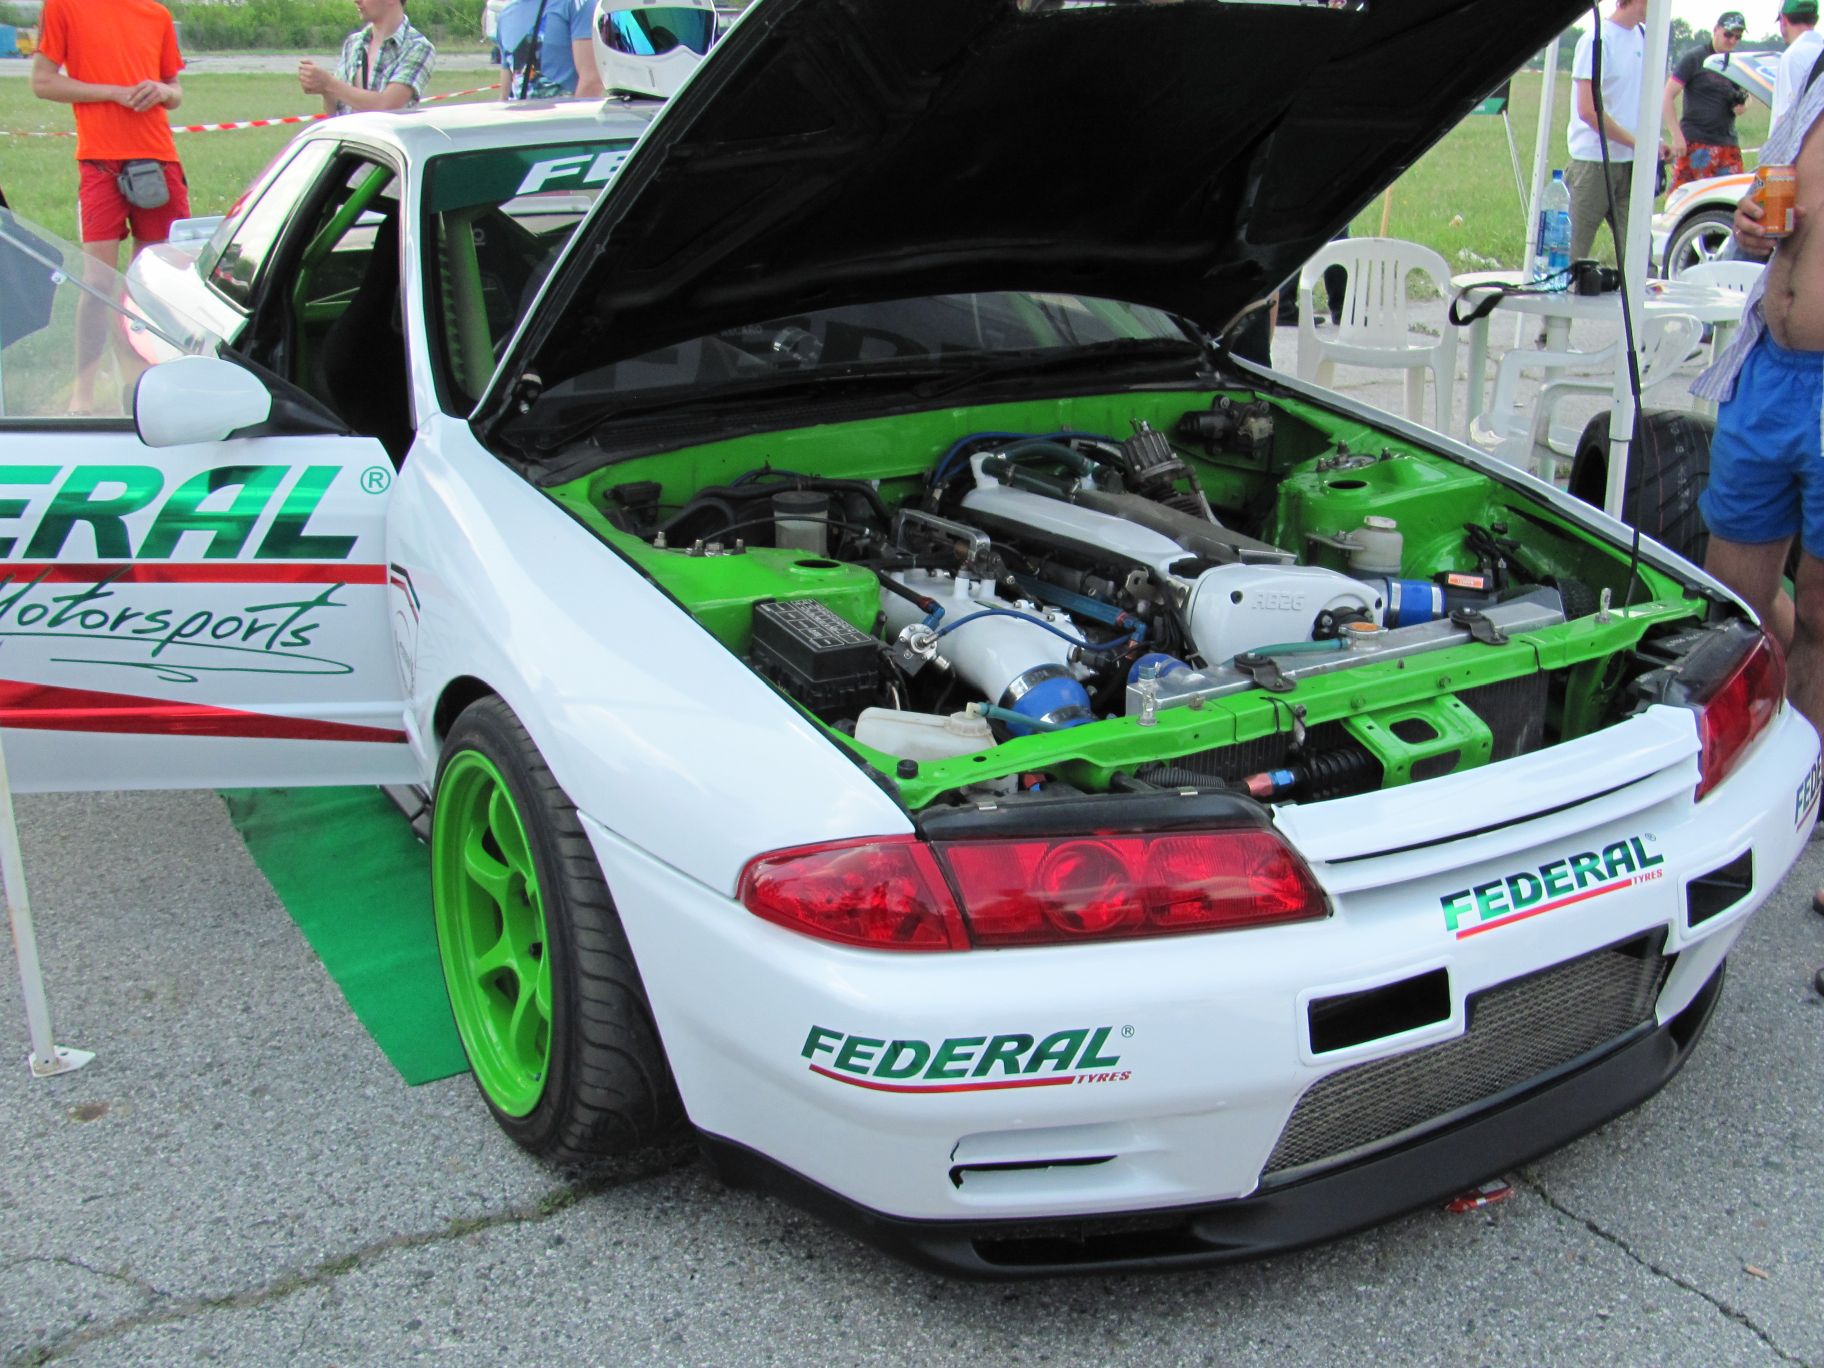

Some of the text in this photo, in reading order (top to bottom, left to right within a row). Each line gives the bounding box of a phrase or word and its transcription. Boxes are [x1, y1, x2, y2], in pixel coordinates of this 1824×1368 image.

[1440, 836, 1664, 932] FEDERAL
[1633, 868, 1663, 885] TYRES
[800, 1025, 1121, 1080] FEDERAL
[1077, 1070, 1132, 1084] TYRES
